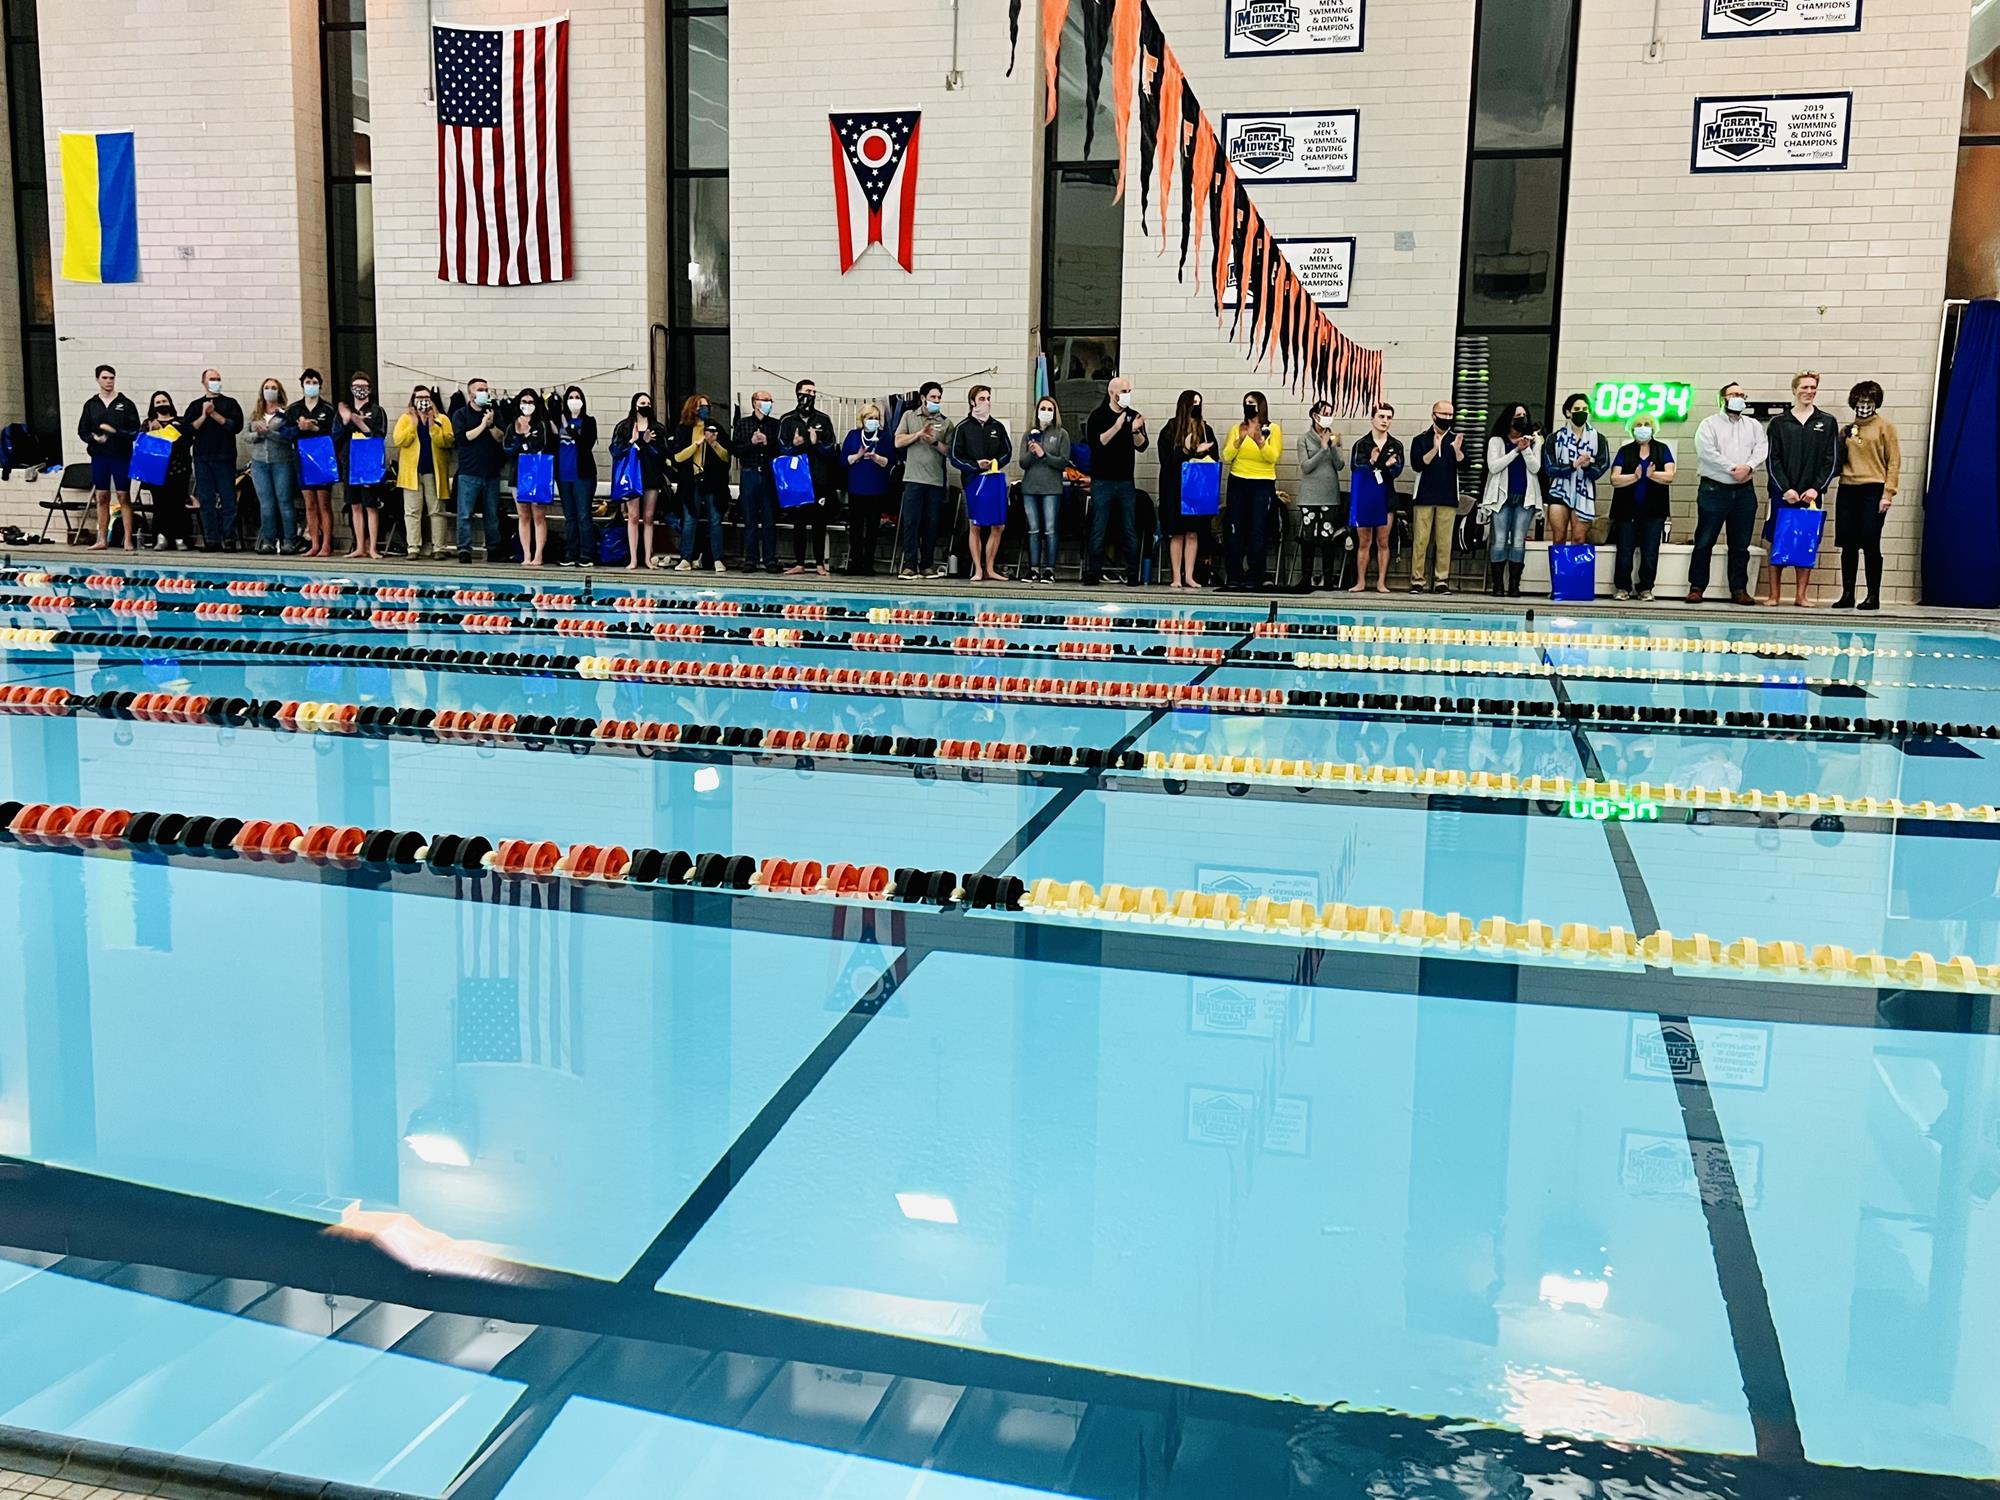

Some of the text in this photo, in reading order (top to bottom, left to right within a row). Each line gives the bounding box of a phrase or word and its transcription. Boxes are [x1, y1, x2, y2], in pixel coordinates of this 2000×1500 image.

[1252, 4, 1282, 13] GREAT
[1717, 2, 1746, 11] ATHLETIC
[1796, 2, 1851, 10] CHAMPIONS
[1309, 7, 1353, 15] SWIMMING
[1238, 9, 1298, 27] MIDWEST
[1321, 15, 1349, 23] DIVING
[1238, 24, 1262, 32] ATHLETIC
[1306, 24, 1354, 32] CHAMPIONS
[1724, 118, 1758, 127] GREAT
[1788, 122, 1836, 130] SWIMMING
[1706, 122, 1774, 141] MIDWEST
[1303, 136, 1348, 144] SWIMMING
[1705, 138, 1734, 146] ATHLETIC
[1784, 139, 1838, 147] CHAMPIONS
[1232, 138, 1292, 154] MIDWEST
[1232, 152, 1257, 160] ATHLETIC
[1300, 153, 1348, 161] CHAMPIONS
[1300, 264, 1342, 272] SWIMMING
[1594, 383, 1690, 418] 08:34
